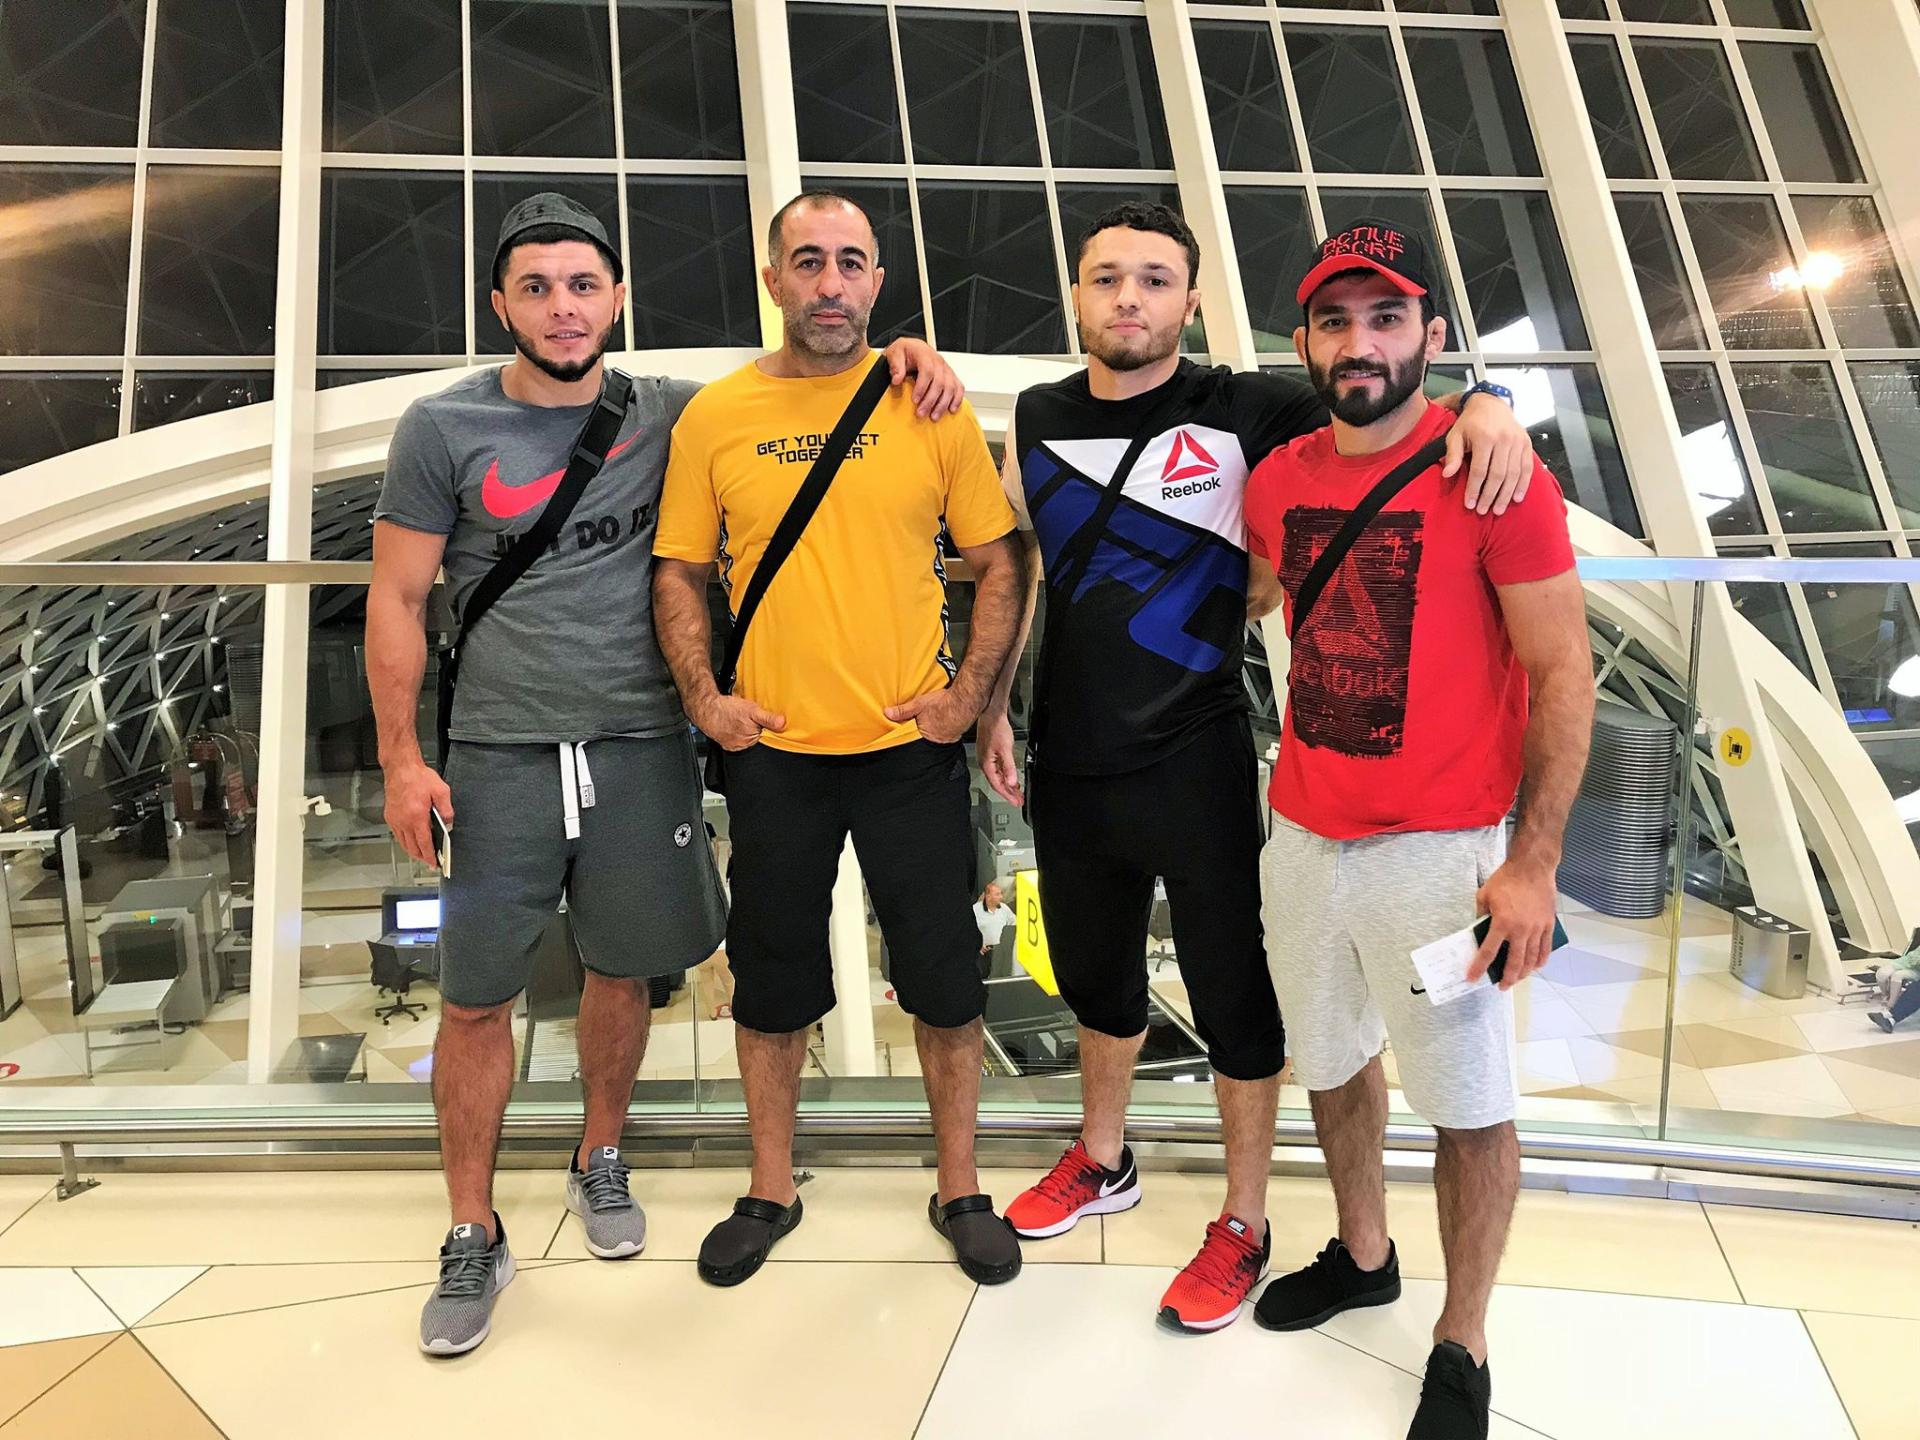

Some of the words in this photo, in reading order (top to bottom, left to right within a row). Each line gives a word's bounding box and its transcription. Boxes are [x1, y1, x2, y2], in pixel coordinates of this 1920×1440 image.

[757, 438, 788, 455] GET
[794, 433, 834, 448] YOU
[852, 433, 879, 446] CT
[775, 447, 863, 464] TOGEER
[1161, 476, 1222, 501] Reebok
[493, 529, 562, 557] JUT
[575, 515, 620, 549] DO
[1027, 897, 1039, 947] B
